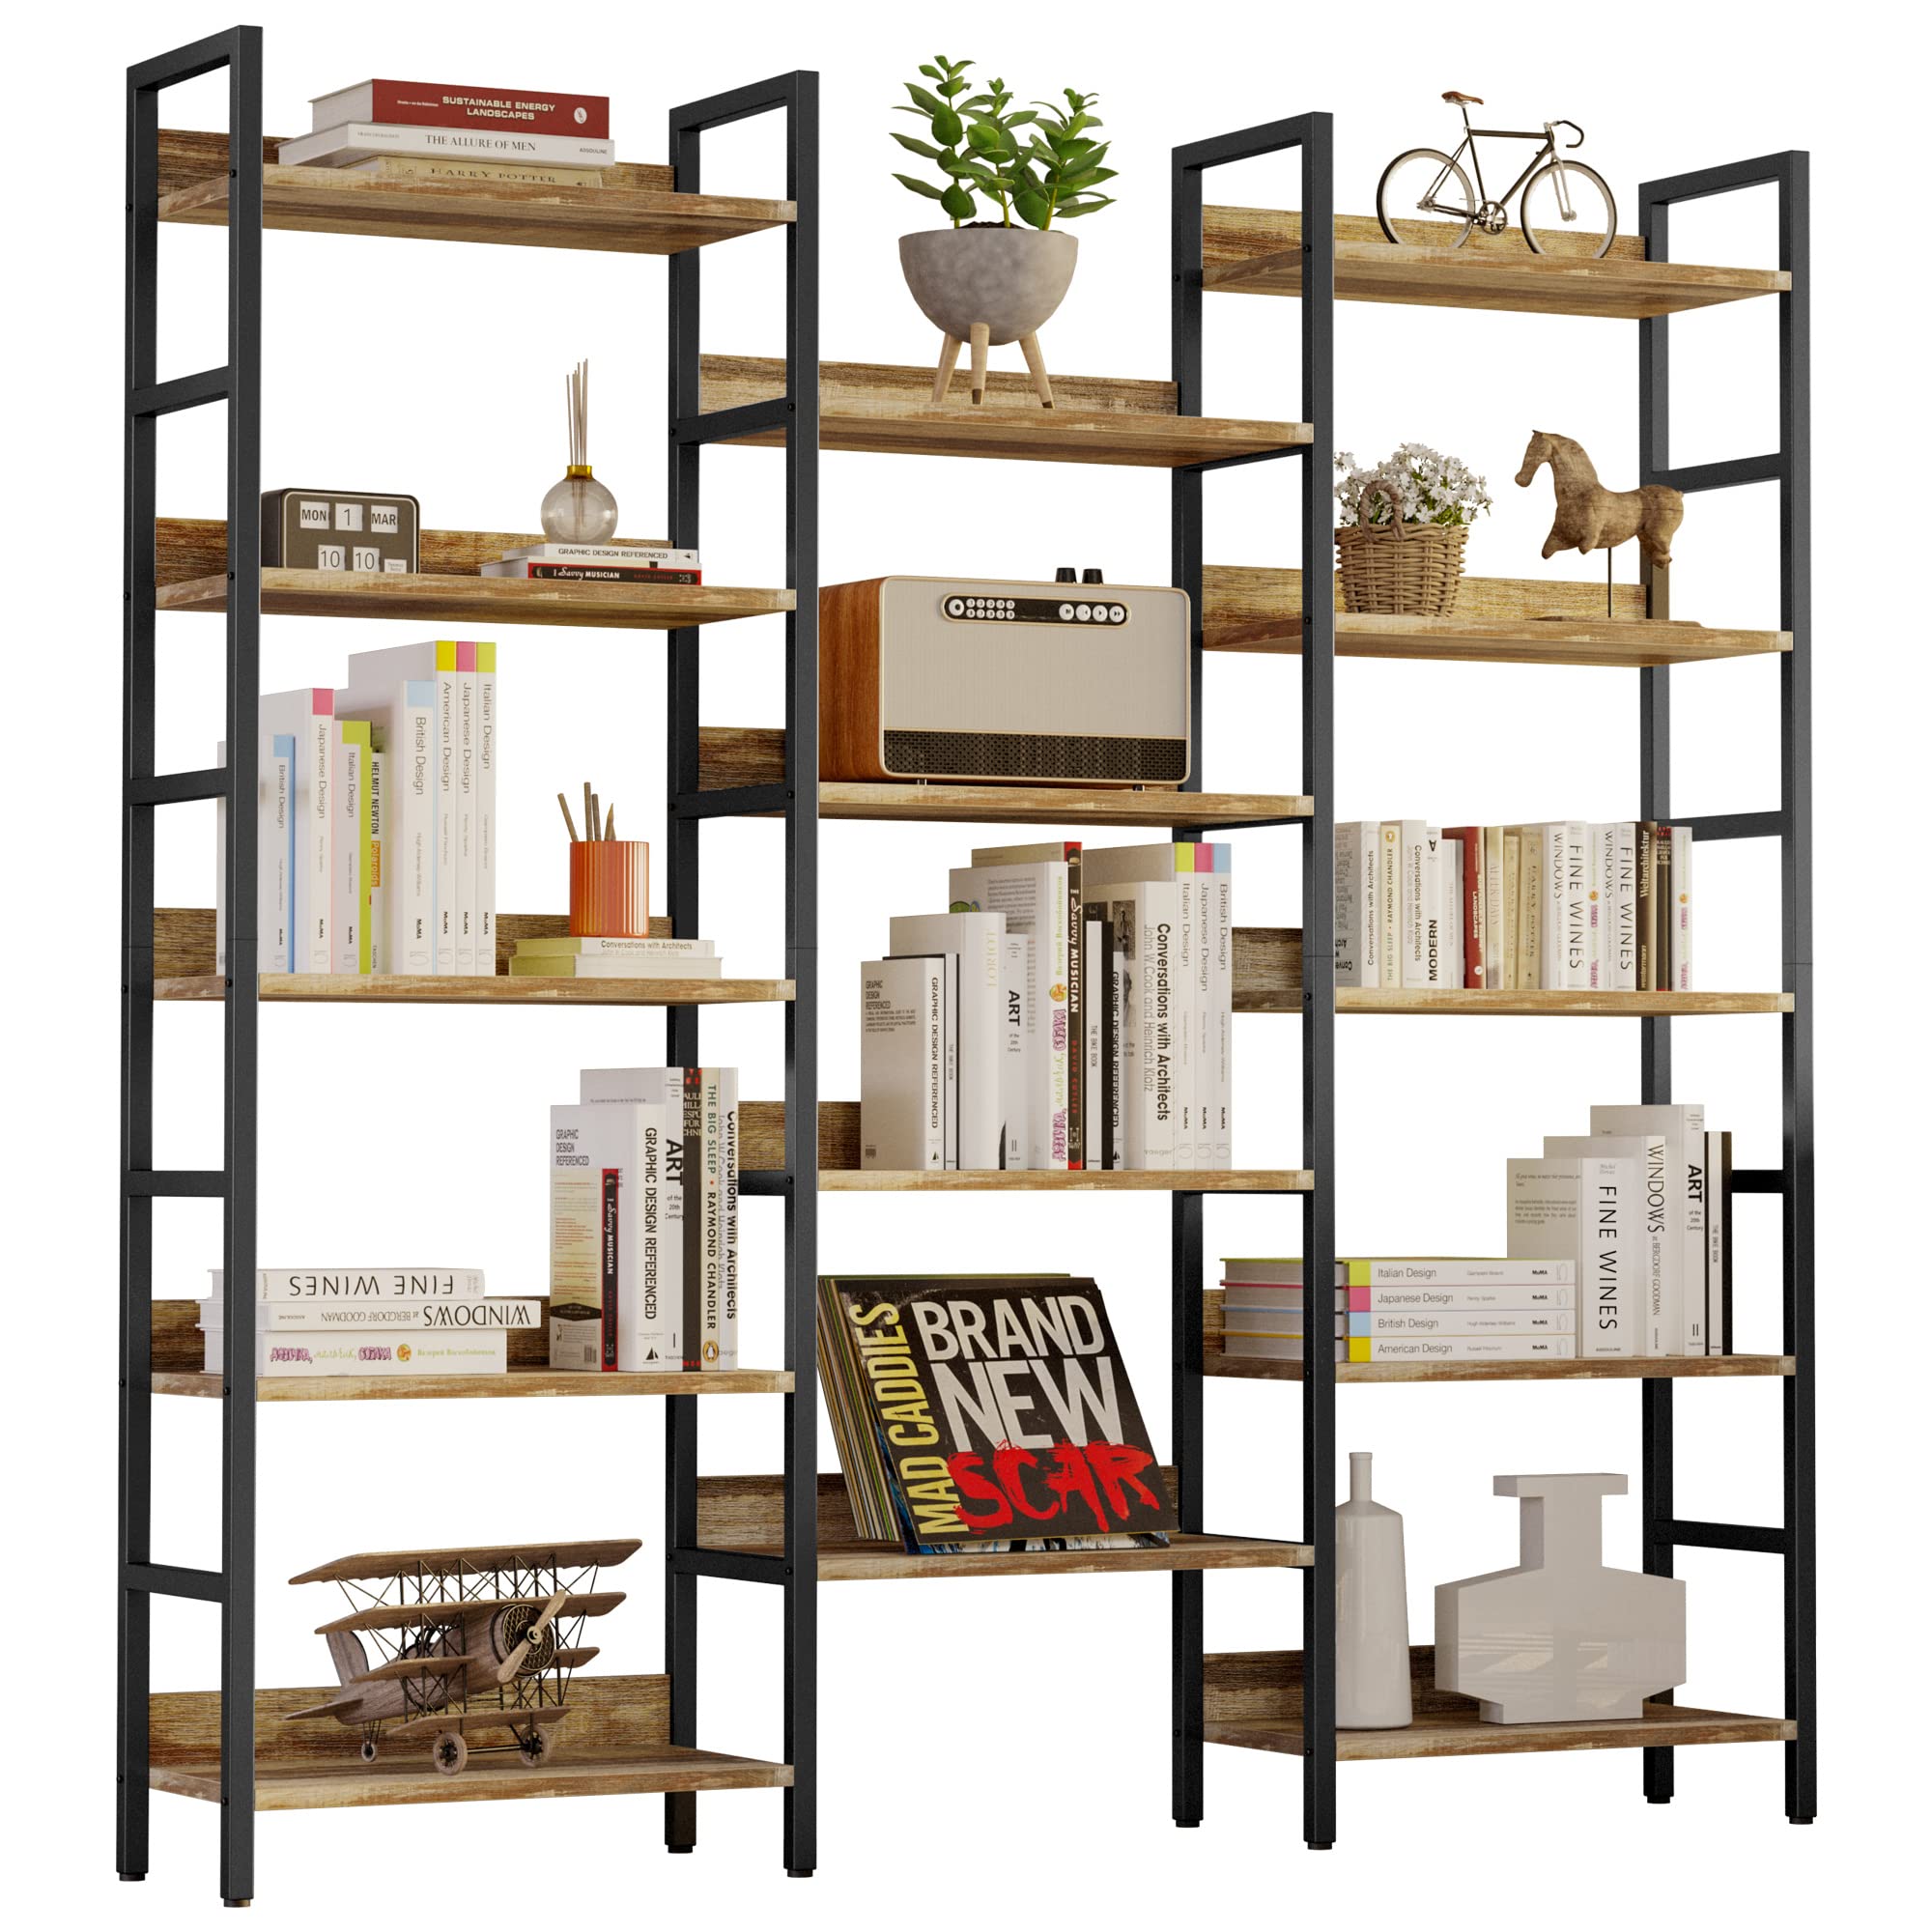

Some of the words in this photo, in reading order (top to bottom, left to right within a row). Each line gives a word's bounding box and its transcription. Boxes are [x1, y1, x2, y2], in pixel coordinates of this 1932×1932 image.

[442, 96, 512, 108] SUSTAINABLE
[515, 101, 555, 112] ENERGY
[467, 108, 535, 120] LANDSCAPES
[425, 134, 447, 145] THE
[450, 136, 493, 149] ALLURE
[495, 139, 510, 150] OF
[512, 141, 535, 152] MEN
[431, 167, 491, 179] HARRY
[498, 172, 556, 184] POTTER
[301, 509, 327, 522] MON
[344, 508, 350, 526] 1
[371, 514, 396, 526] MAR
[321, 550, 340, 568] 10
[355, 552, 375, 570] 10
[558, 548, 591, 556] GRAPHIC
[592, 550, 620, 558] DESIGN
[621, 551, 668, 559] REFERENCED
[558, 566, 584, 580] Savvy
[585, 570, 620, 580] MUSICIAN
[442, 682, 452, 744] American
[462, 682, 471, 746] Japanese
[483, 684, 492, 722] Italian
[317, 724, 327, 779] Japanese
[415, 717, 426, 753] British
[482, 725, 492, 769] Design
[413, 756, 426, 795] Design
[441, 748, 452, 791] Design
[462, 749, 471, 793] Design
[317, 781, 327, 819] Design
[371, 841, 380, 886] Polaroids
[1554, 833, 1564, 898] WINDOWS
[1570, 845, 1584, 890] FINE
[1605, 831, 1613, 898] WINDOWS
[1620, 846, 1633, 893] FINE
[1640, 831, 1650, 897] Weltarchitektur
[1066, 896, 1082, 946] Savvy
[1200, 883, 1209, 944] Japanese
[1219, 884, 1228, 922] British
[601, 941, 645, 950] Conversations
[1144, 924, 1155, 950] John
[1219, 926, 1228, 970] Design
[1429, 920, 1437, 981] MODERN
[1570, 901, 1584, 968] WINES
[1620, 902, 1633, 970] WINES
[1157, 923, 1171, 1018] Conversations
[1200, 949, 1209, 991] Design
[1009, 991, 1020, 1026] ART
[1144, 997, 1155, 1018] and
[1144, 1022, 1155, 1064] Heinrich
[1157, 1022, 1171, 1051] with
[707, 1086, 717, 1107] THE
[1144, 1068, 1155, 1092] Klotz
[1157, 1055, 1171, 1121] Architects
[556, 1129, 579, 1140] GRAPHIC
[707, 1113, 717, 1133] BIG
[556, 1142, 575, 1152] DESIGN
[556, 1155, 589, 1166] REFERENCED
[645, 1127, 657, 1183] GRAPHIC
[667, 1140, 684, 1185] ART
[707, 1140, 717, 1174] SLEEP
[726, 1111, 737, 1211] Conversations
[1648, 1144, 1665, 1233] WINDOWS
[1689, 1165, 1702, 1203] ART
[605, 1204, 616, 1233] Savvy
[645, 1187, 657, 1234] DESIGN
[707, 1192, 717, 1258] RAYMOND
[726, 1215, 737, 1246] with
[1600, 1186, 1617, 1238] FINE
[290, 1275, 380, 1296] WINES
[394, 1275, 453, 1294] FINE
[645, 1238, 657, 1320] REFERENCED
[726, 1250, 737, 1320] Architects
[1378, 1268, 1404, 1277] Italian
[1406, 1268, 1436, 1279] Design
[1600, 1250, 1617, 1329] WINES
[321, 1312, 365, 1321] GOODMAN
[367, 1312, 412, 1321] BERGDORF
[423, 1305, 531, 1325] WINDOWS
[707, 1264, 717, 1329] CHANDLER
[1378, 1294, 1420, 1304] Japanese
[1422, 1293, 1453, 1304] Design
[911, 1294, 1106, 1361] BRAND
[1378, 1320, 1406, 1328] British
[1408, 1319, 1438, 1329] Design
[1378, 1345, 1420, 1353] American
[1422, 1345, 1453, 1354] Design
[849, 1302, 940, 1447] CADDIES
[930, 1356, 1124, 1453] NEW
[898, 1455, 970, 1534] MAD
[947, 1439, 1160, 1534] SCAR
